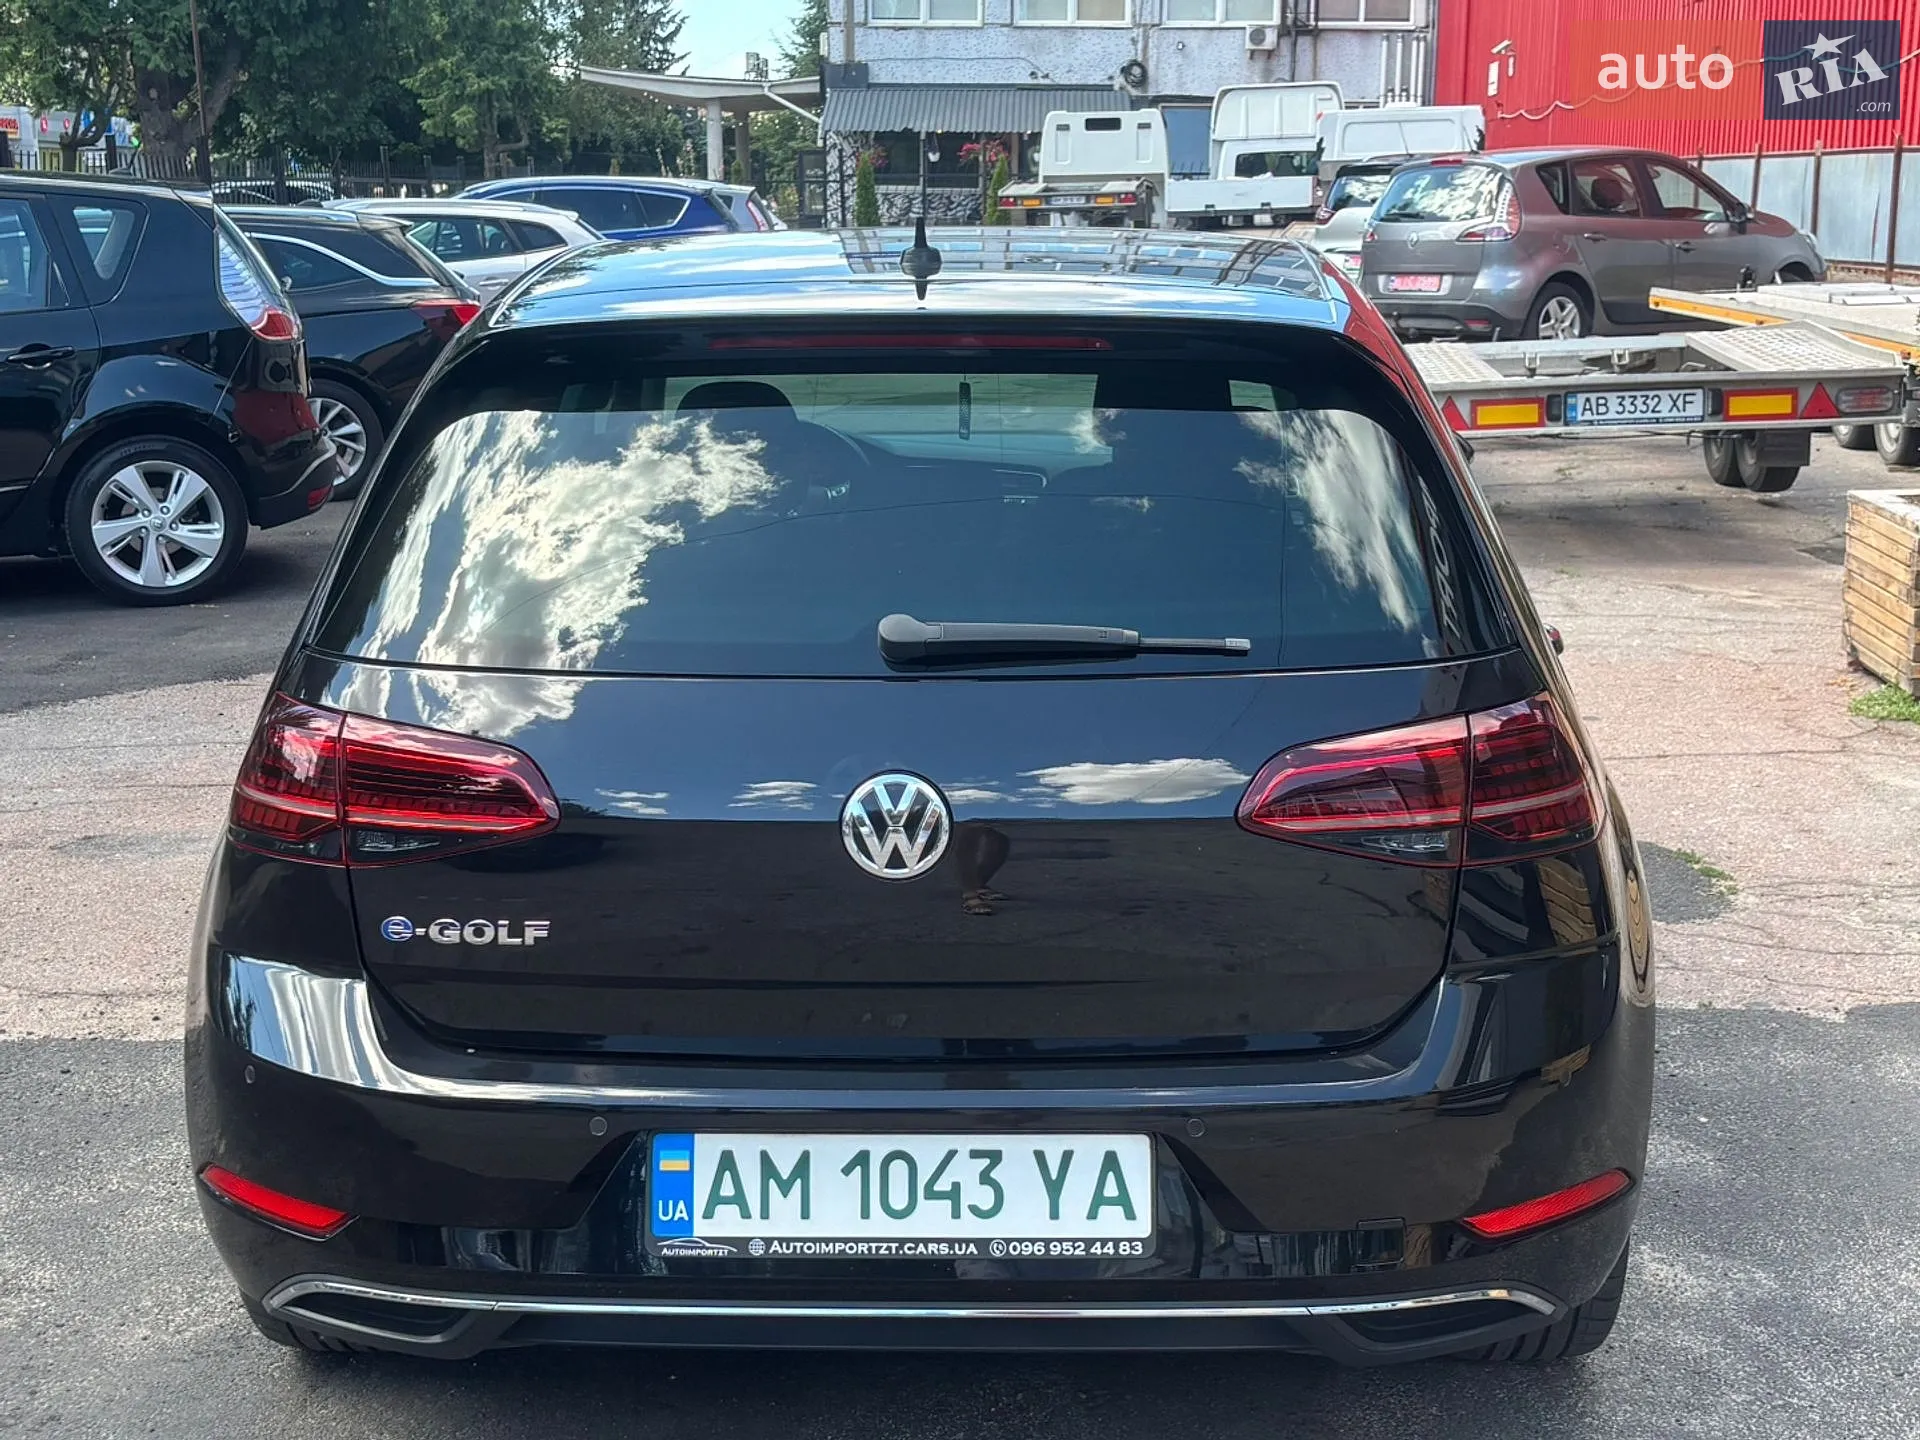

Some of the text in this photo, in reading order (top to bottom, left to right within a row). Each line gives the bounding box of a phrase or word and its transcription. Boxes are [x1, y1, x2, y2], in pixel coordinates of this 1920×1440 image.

[1581, 392, 1697, 417] AB 3332 XF
[381, 915, 551, 945] e-GOLF
[702, 1149, 1137, 1221] AM 1043 YA
[658, 1199, 689, 1222] UA
[661, 1247, 729, 1256] AUTOIMPORTZT
[769, 1240, 978, 1255] AUTOIMPORTZT.CARS.UA
[1009, 1241, 1143, 1256] 096 952 44 83
